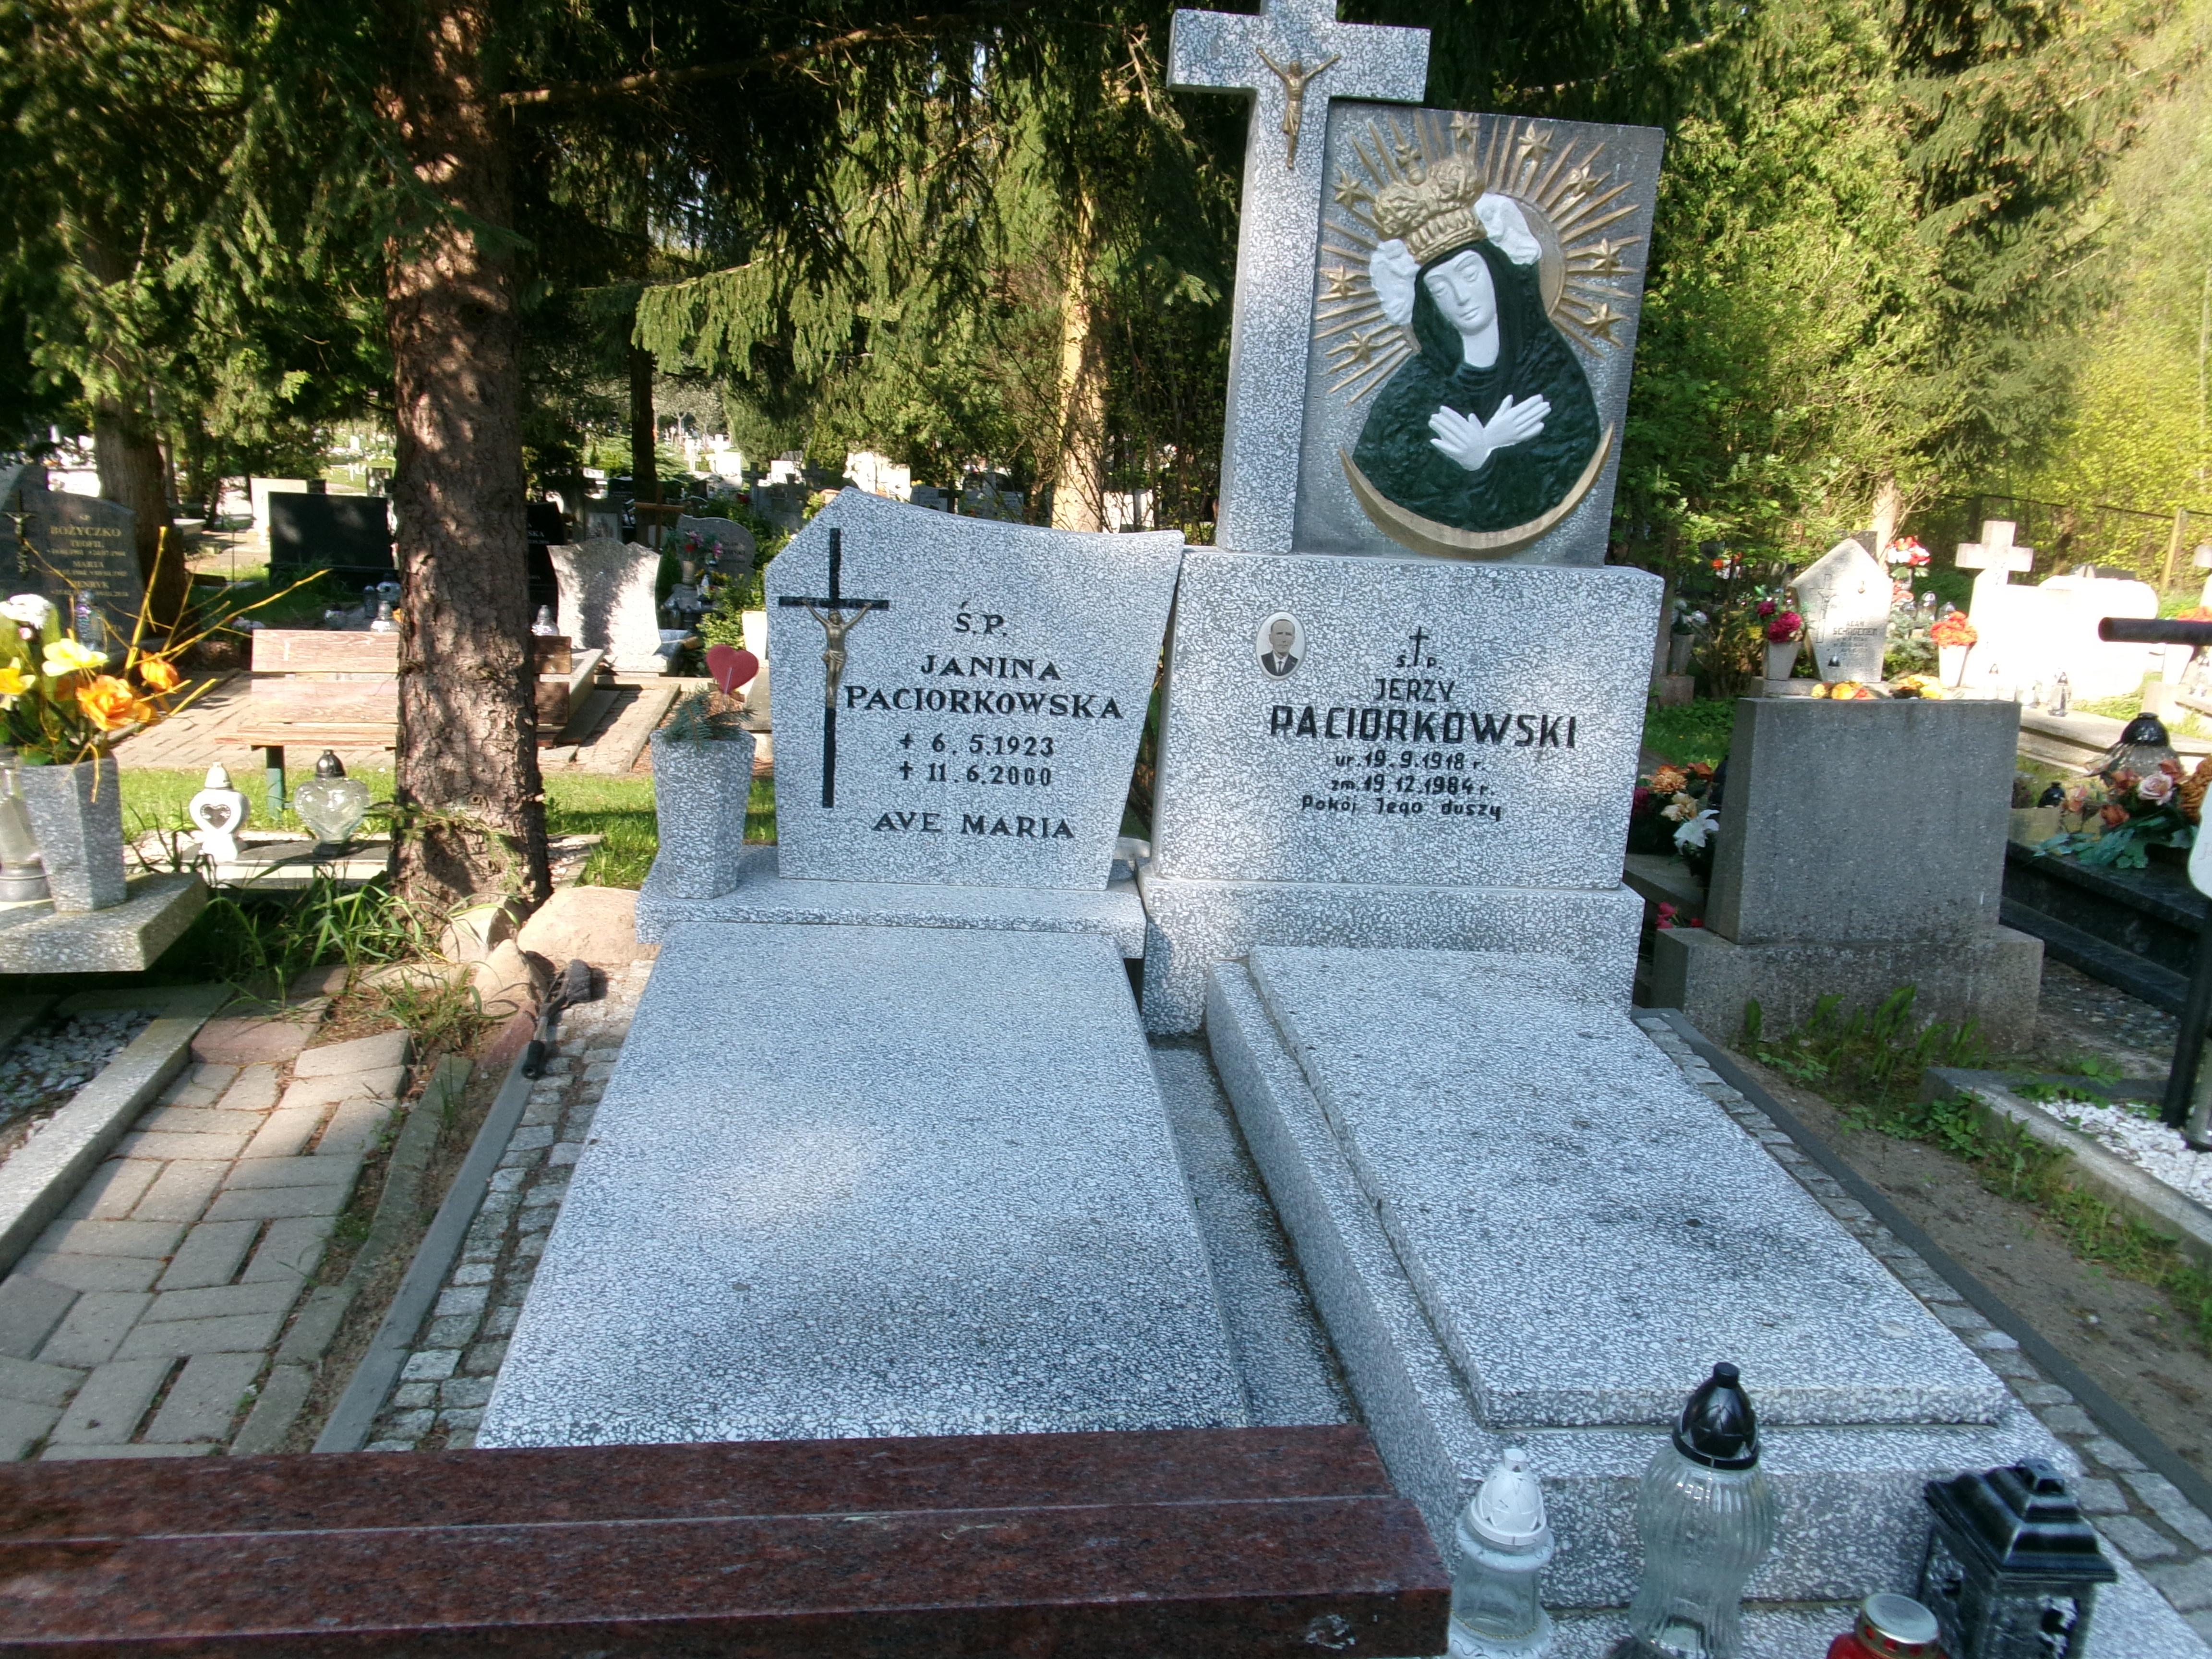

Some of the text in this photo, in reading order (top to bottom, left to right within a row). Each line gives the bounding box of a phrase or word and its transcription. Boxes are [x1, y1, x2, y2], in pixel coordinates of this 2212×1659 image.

[921, 655, 1062, 681] JANINA
[844, 685, 1124, 719] PACIORKOWSKA
[1374, 677, 1455, 702] JERZY
[1270, 705, 1577, 749] PACIORKOWSKI
[1302, 795, 1501, 821] Pokój Jego duszy
[872, 812, 1075, 839] AVE MARIA
